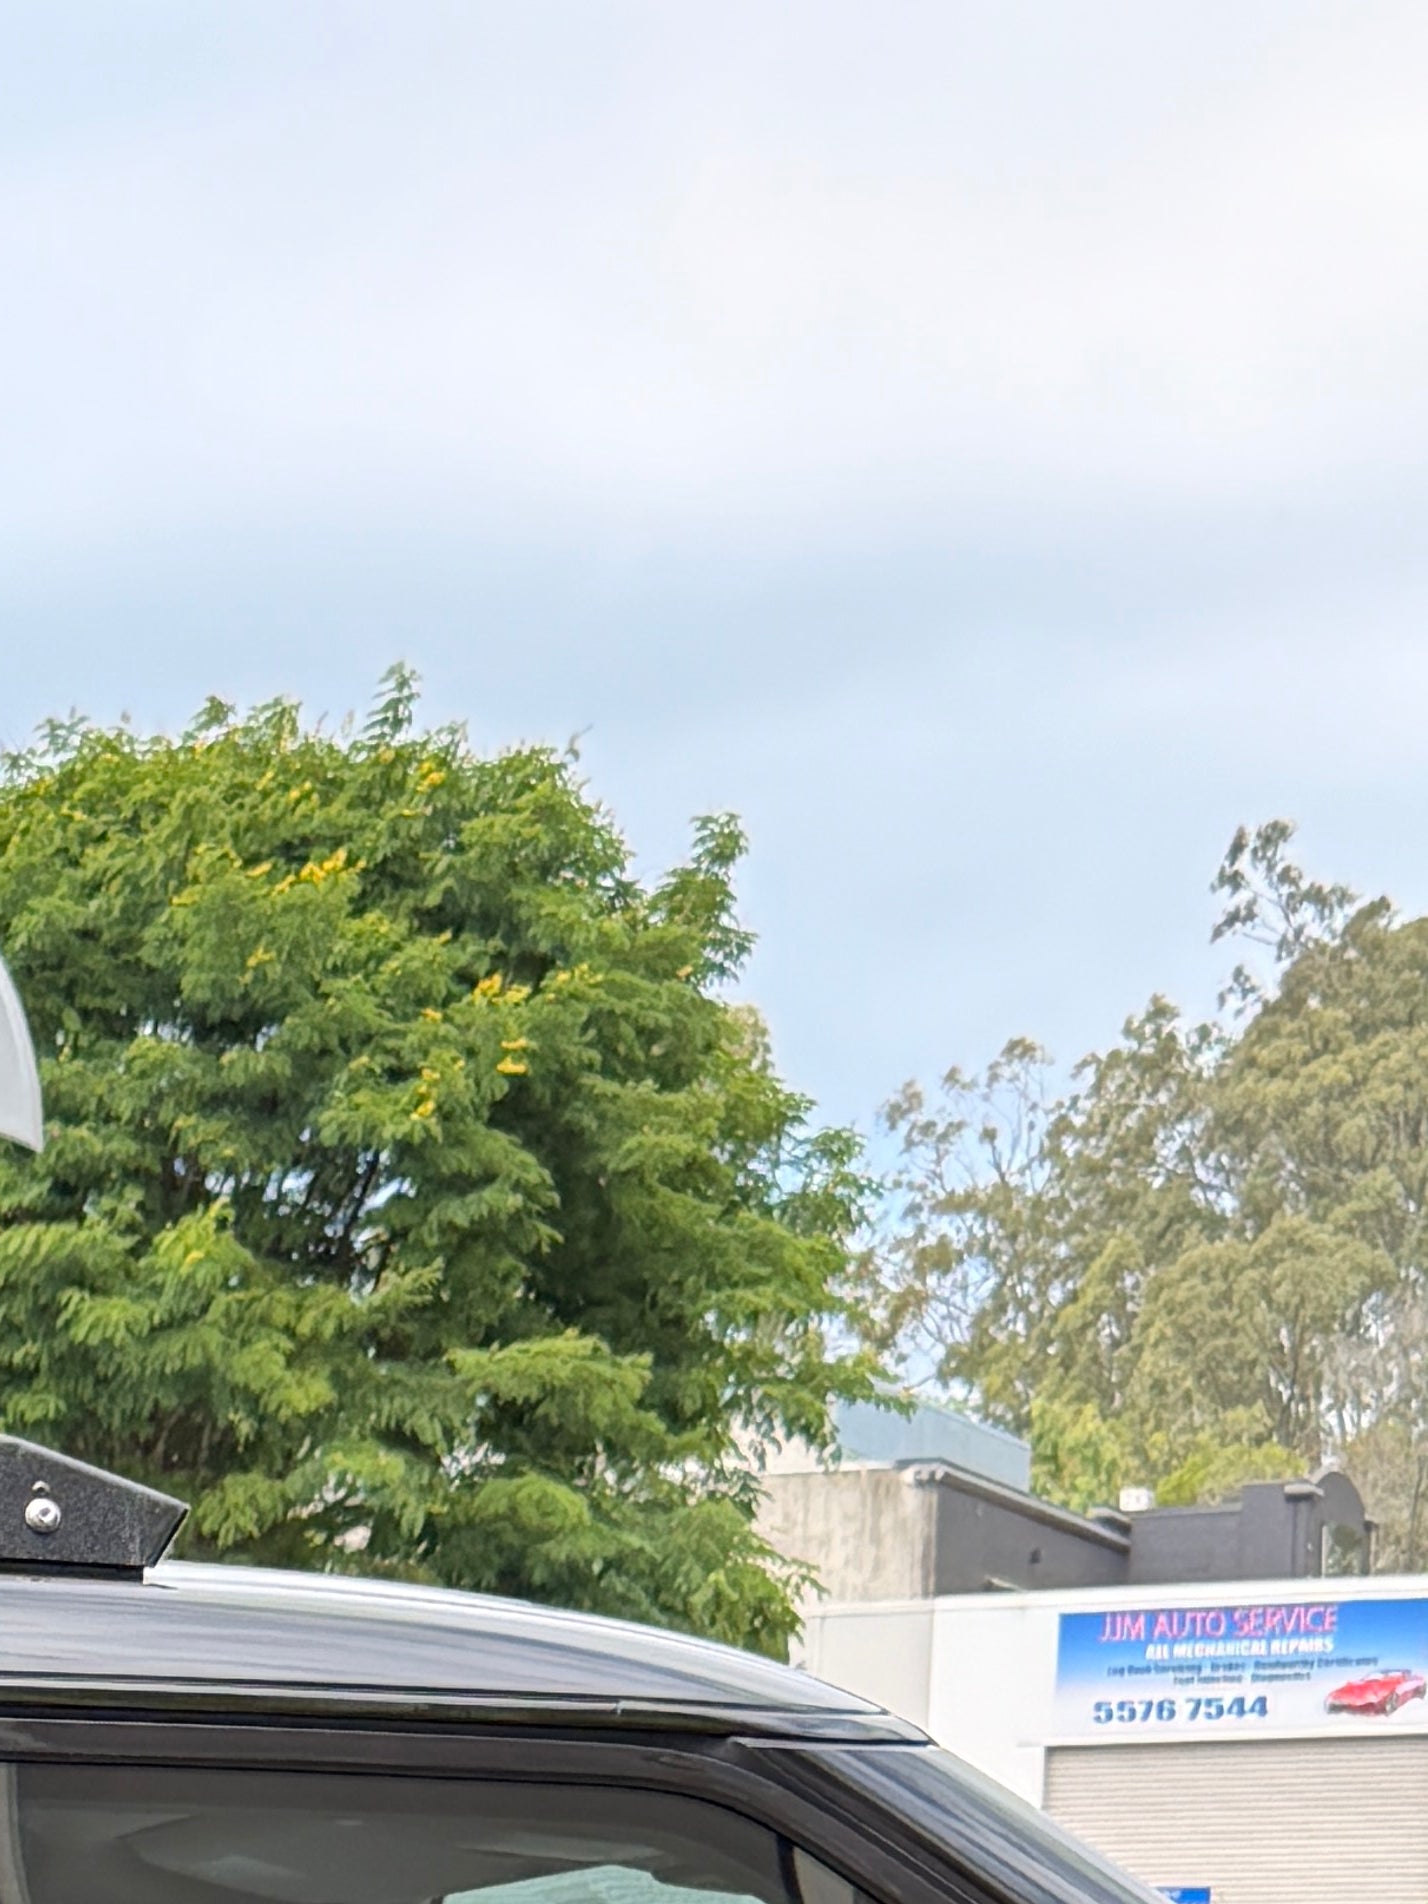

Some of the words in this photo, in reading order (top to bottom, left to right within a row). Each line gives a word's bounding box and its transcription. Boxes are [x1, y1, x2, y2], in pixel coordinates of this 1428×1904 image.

[1100, 1613, 1145, 1642] JJM
[1152, 1609, 1226, 1640] AUTO
[1231, 1604, 1338, 1637] SERVICE
[1145, 1642, 1170, 1661] ALL
[1172, 1637, 1267, 1659] MECHANICAL
[1269, 1634, 1335, 1656] REPAIRS
[1093, 1698, 1176, 1725] 5576
[1184, 1694, 1269, 1721] 7544
